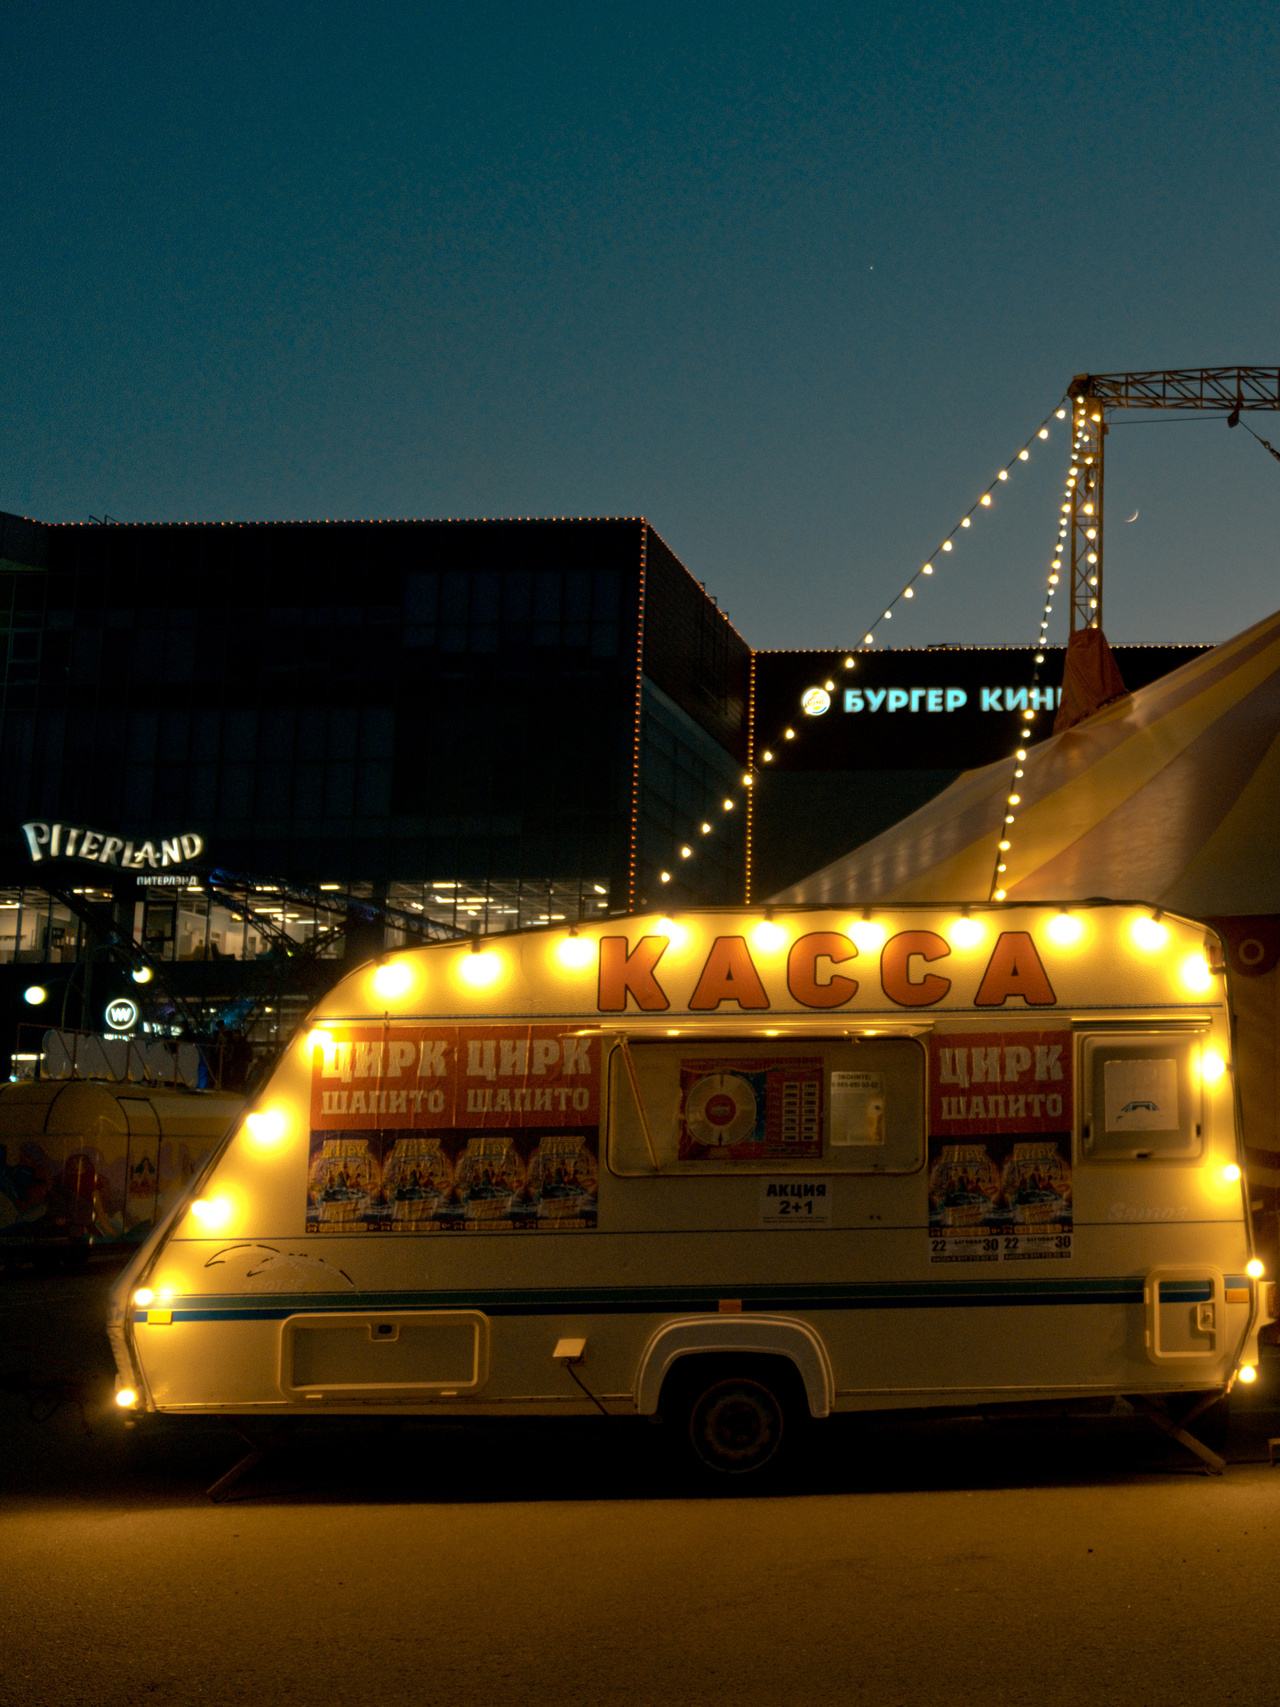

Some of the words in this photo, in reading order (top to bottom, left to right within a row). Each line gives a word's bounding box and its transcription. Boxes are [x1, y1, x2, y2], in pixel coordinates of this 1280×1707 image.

[843, 687, 968, 713] БУРГЕР
[980, 687, 1063, 712] КИН
[22, 821, 205, 870] PITERLAND
[136, 875, 199, 887] ПИТЕРЛЭНД
[597, 930, 1057, 1011] КАССА
[321, 1040, 447, 1083] ЦИРК
[466, 1038, 592, 1081] ЦИРК
[939, 1044, 1064, 1088] ЦИРК
[321, 1090, 445, 1115] ШАПИТО
[466, 1087, 590, 1113] ШАПИТО
[941, 1093, 1063, 1120] ШАПИТО
[766, 1184, 827, 1198] АКЦИЯ
[779, 1201, 813, 1214] 2+1
[931, 1240, 946, 1252] 22
[983, 1239, 999, 1251] 30
[1005, 1238, 1019, 1249] 22
[1055, 1236, 1071, 1248] 30
